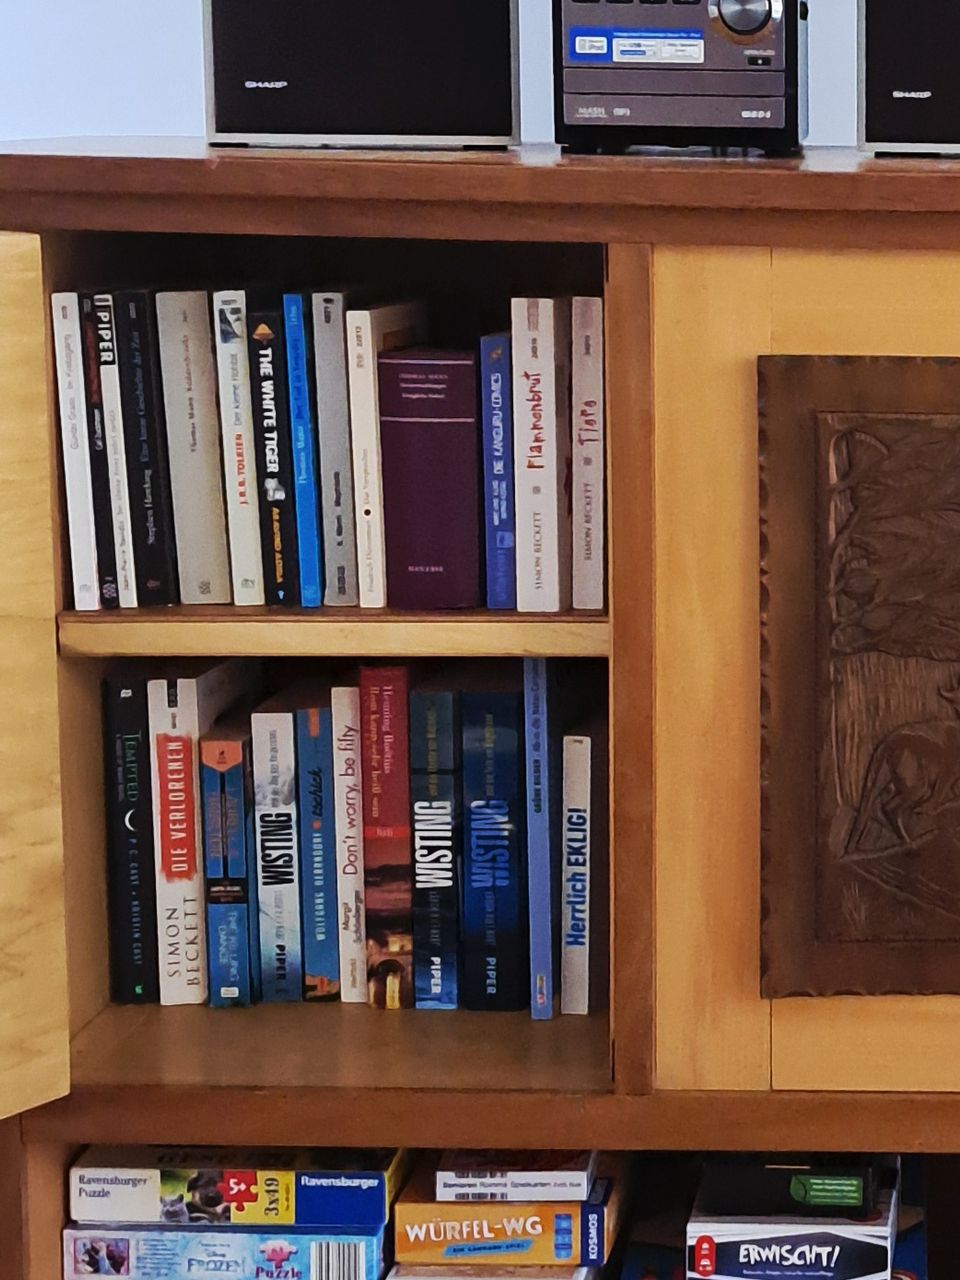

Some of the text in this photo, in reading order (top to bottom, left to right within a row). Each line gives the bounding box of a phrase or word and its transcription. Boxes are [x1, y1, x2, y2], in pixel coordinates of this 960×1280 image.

[97, 311, 112, 363] PIPER
[259, 347, 279, 473] THE WHITE TIGER
[235, 433, 245, 475] TOLKIEN
[532, 511, 542, 553] BECKETT
[534, 557, 543, 590] SIMON
[340, 756, 356, 777] be
[167, 740, 189, 872] DIE VERLORENEN
[342, 783, 359, 830] worry,
[260, 812, 294, 886] WISTING
[342, 835, 358, 875] Don't
[414, 800, 453, 888] WISTING
[470, 800, 513, 888] WISTING
[566, 808, 588, 947] Herrlich EKLIG!
[165, 907, 181, 977] SIMON
[183, 895, 200, 986] BECKETT
[275, 944, 286, 981] PIPER
[430, 957, 441, 994] PIPER
[485, 957, 496, 995] PIPER
[78, 1175, 148, 1187] Ravensburger
[78, 1187, 110, 1198] Puzzle
[264, 1177, 280, 1216] 3x49
[301, 1176, 379, 1188] Ravensburger
[405, 1216, 542, 1243] WÜRFEL-WG
[588, 1213, 597, 1259] KOSMOS
[254, 1266, 303, 1280] Puzzle
[739, 1244, 841, 1268] ERWISCHT!
